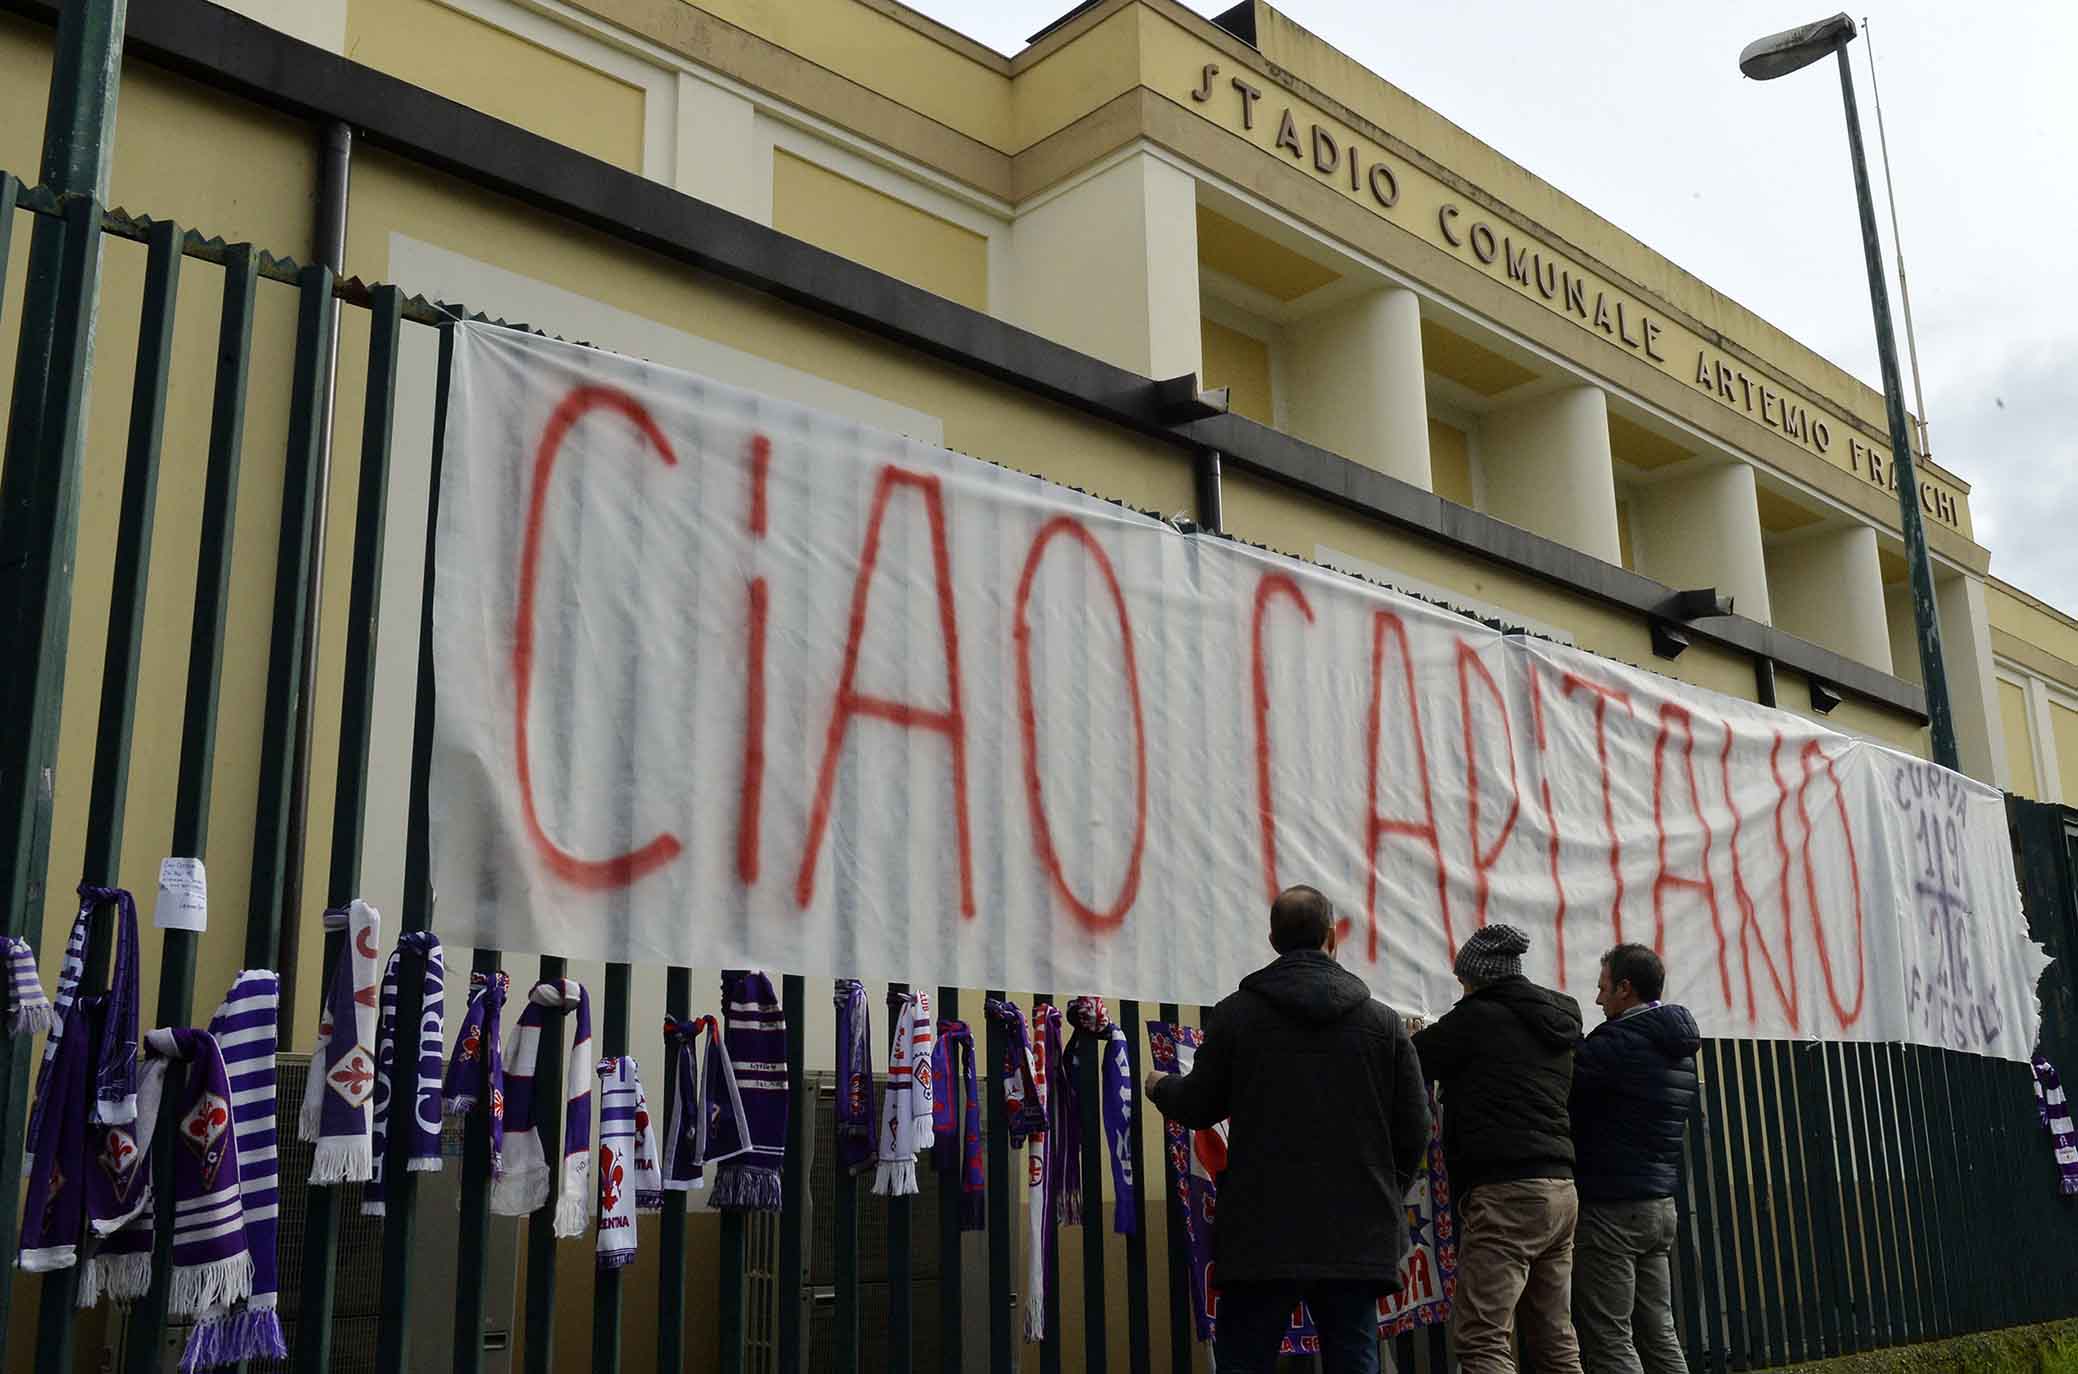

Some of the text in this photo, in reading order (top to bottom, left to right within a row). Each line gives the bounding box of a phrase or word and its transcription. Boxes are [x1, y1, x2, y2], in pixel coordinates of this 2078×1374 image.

[1192, 63, 1958, 527] STADIO COMUNALE ARTEMIO FRCHI
[514, 385, 1865, 1033] CIAO CAPITANO
[1896, 756, 1967, 828] CURVA
